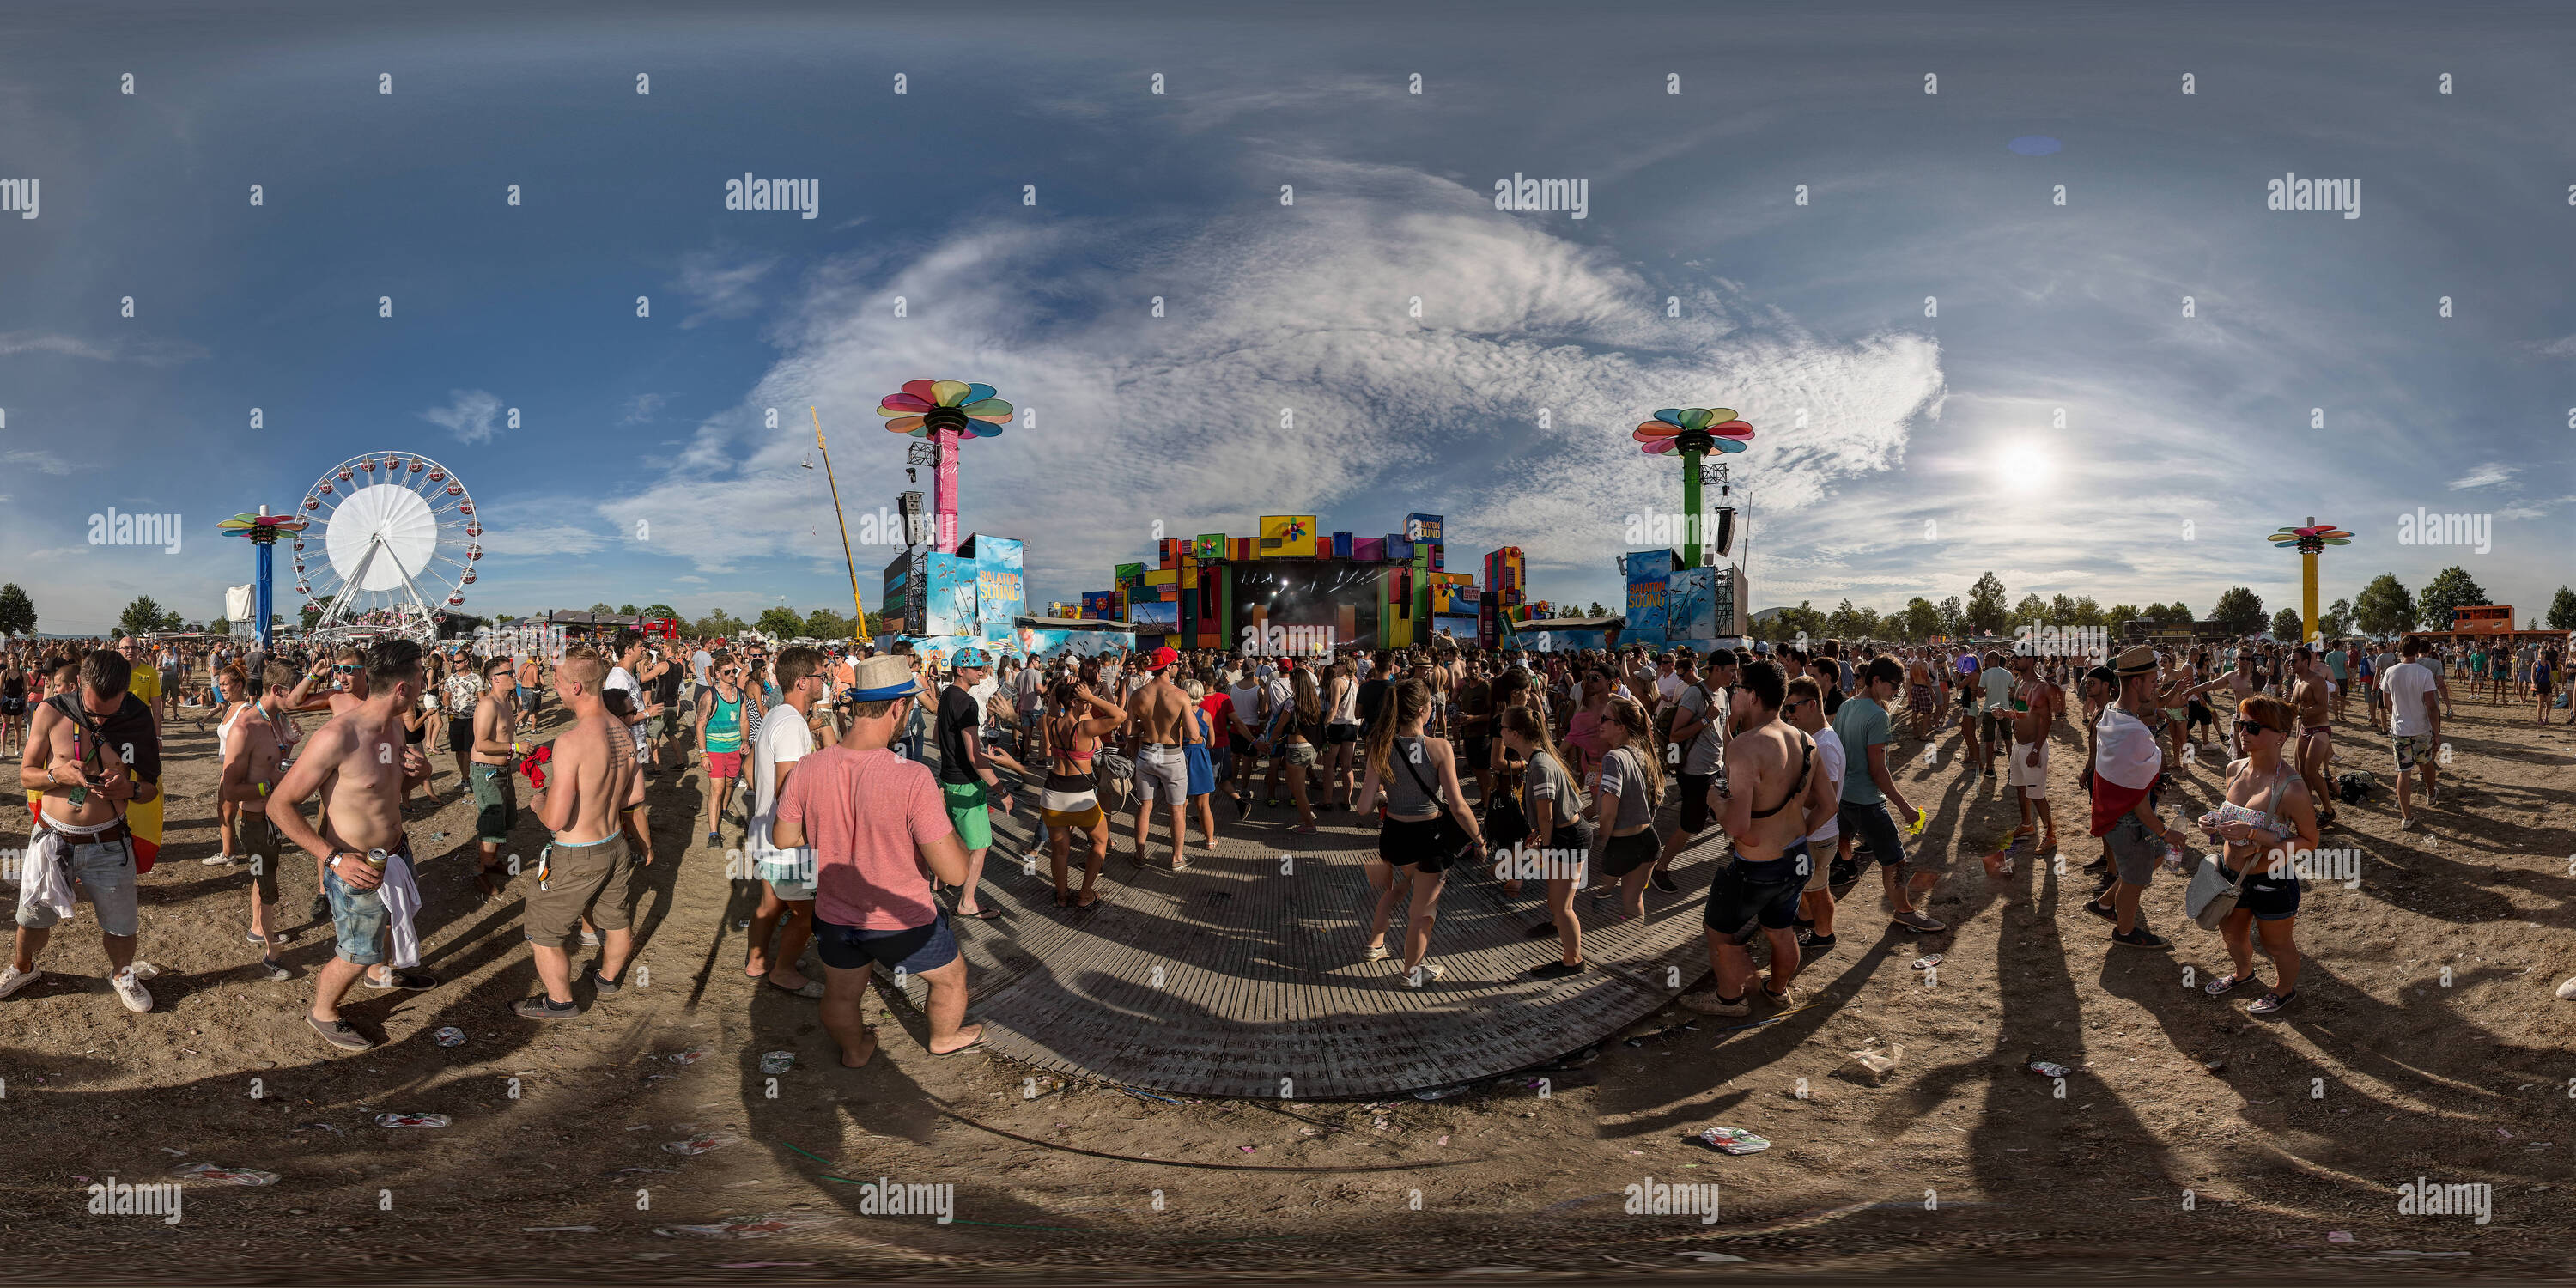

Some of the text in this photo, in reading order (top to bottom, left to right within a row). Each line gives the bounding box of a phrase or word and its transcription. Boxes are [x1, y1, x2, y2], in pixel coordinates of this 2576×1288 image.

[980, 570, 1018, 585] BALATON
[980, 584, 1019, 601] SOUND
[1629, 581, 1665, 594] BALATON
